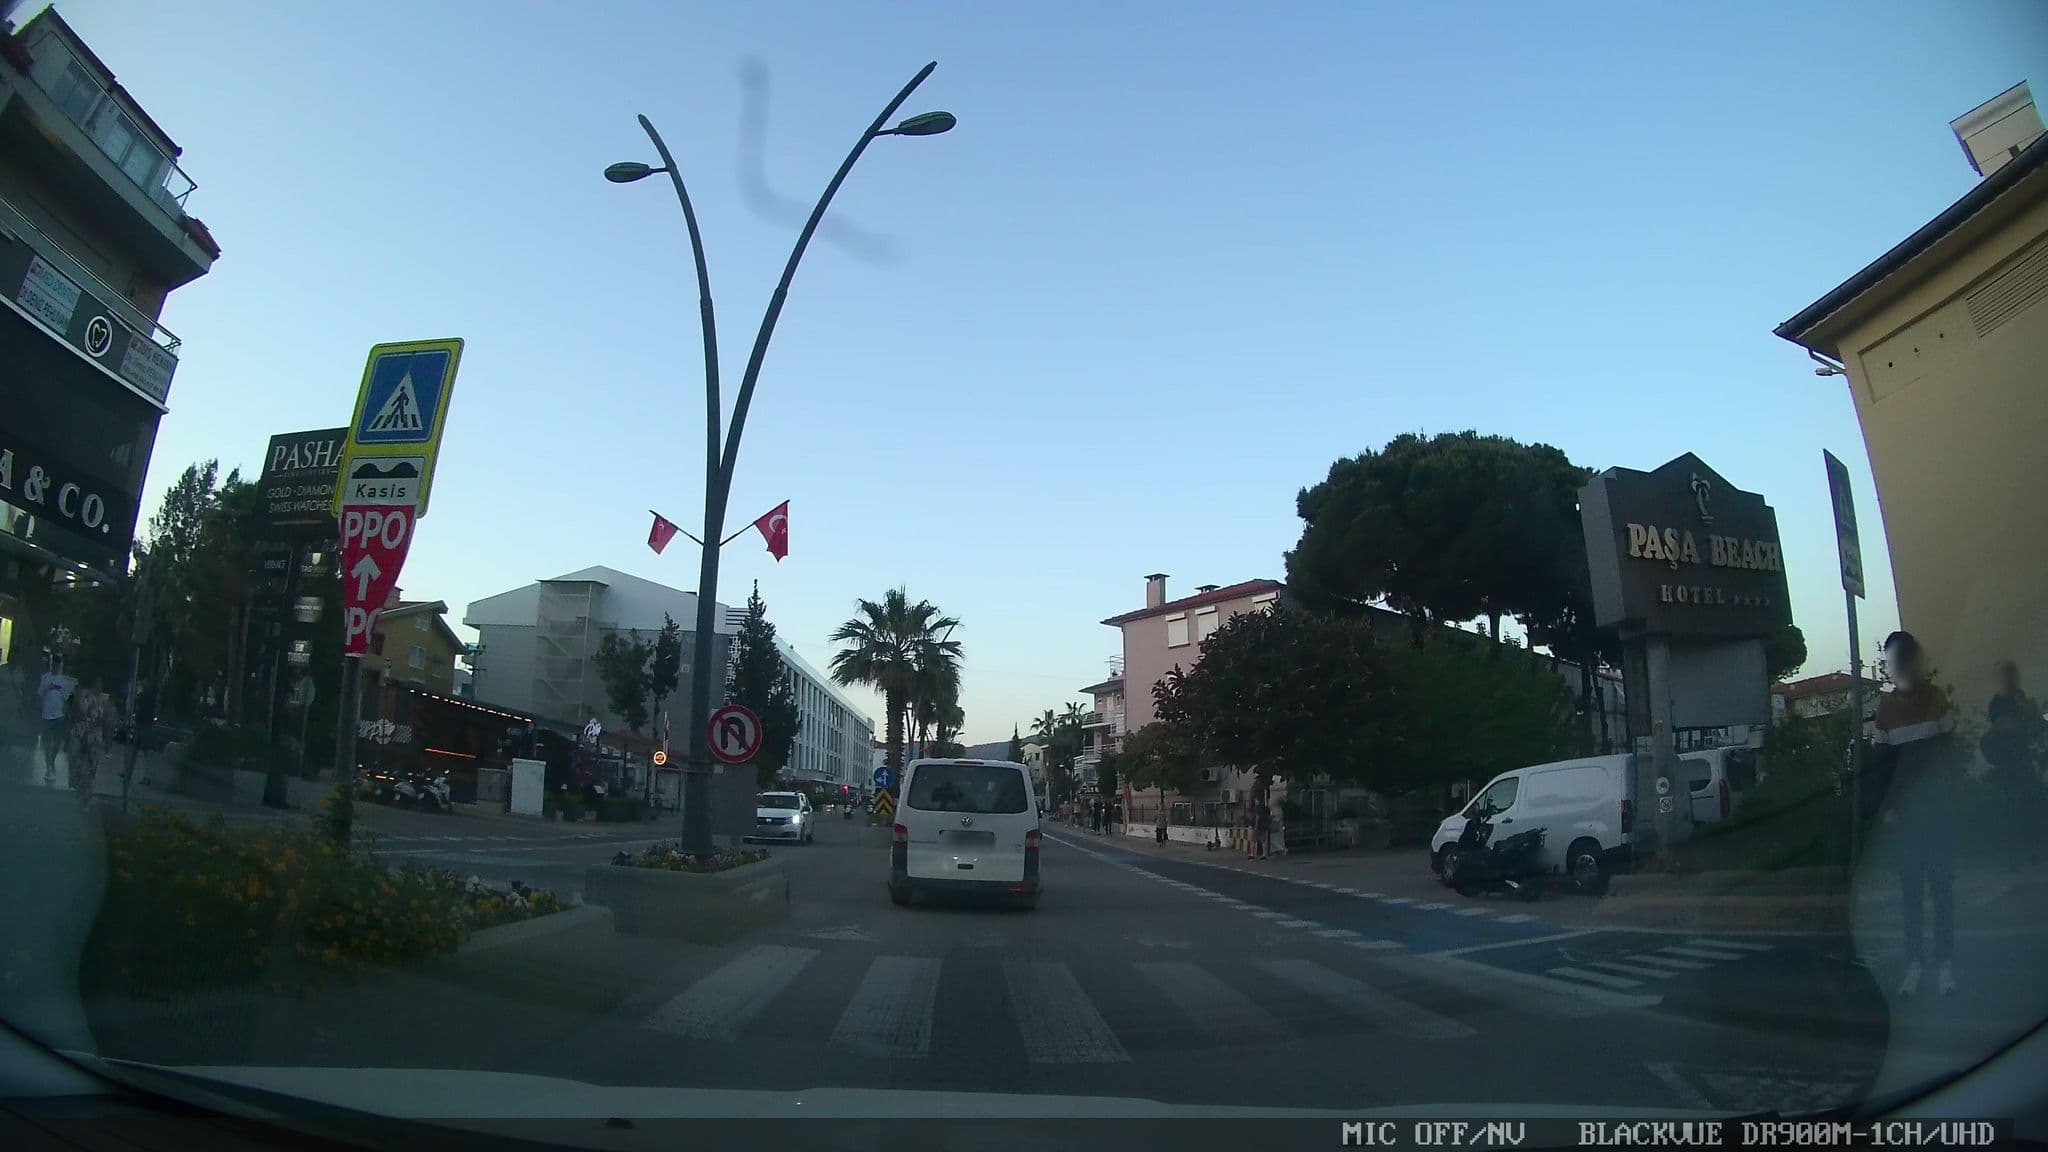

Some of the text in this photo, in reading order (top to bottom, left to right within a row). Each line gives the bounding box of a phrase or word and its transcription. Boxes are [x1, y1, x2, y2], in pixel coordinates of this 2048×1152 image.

[24, 465, 51, 505] &
[59, 482, 109, 534] CO.
[267, 486, 291, 499] GOLD
[355, 483, 406, 499] Kasis
[1627, 522, 1783, 571] PAŞA BEACH
[1660, 584, 1726, 604] HOTEL
